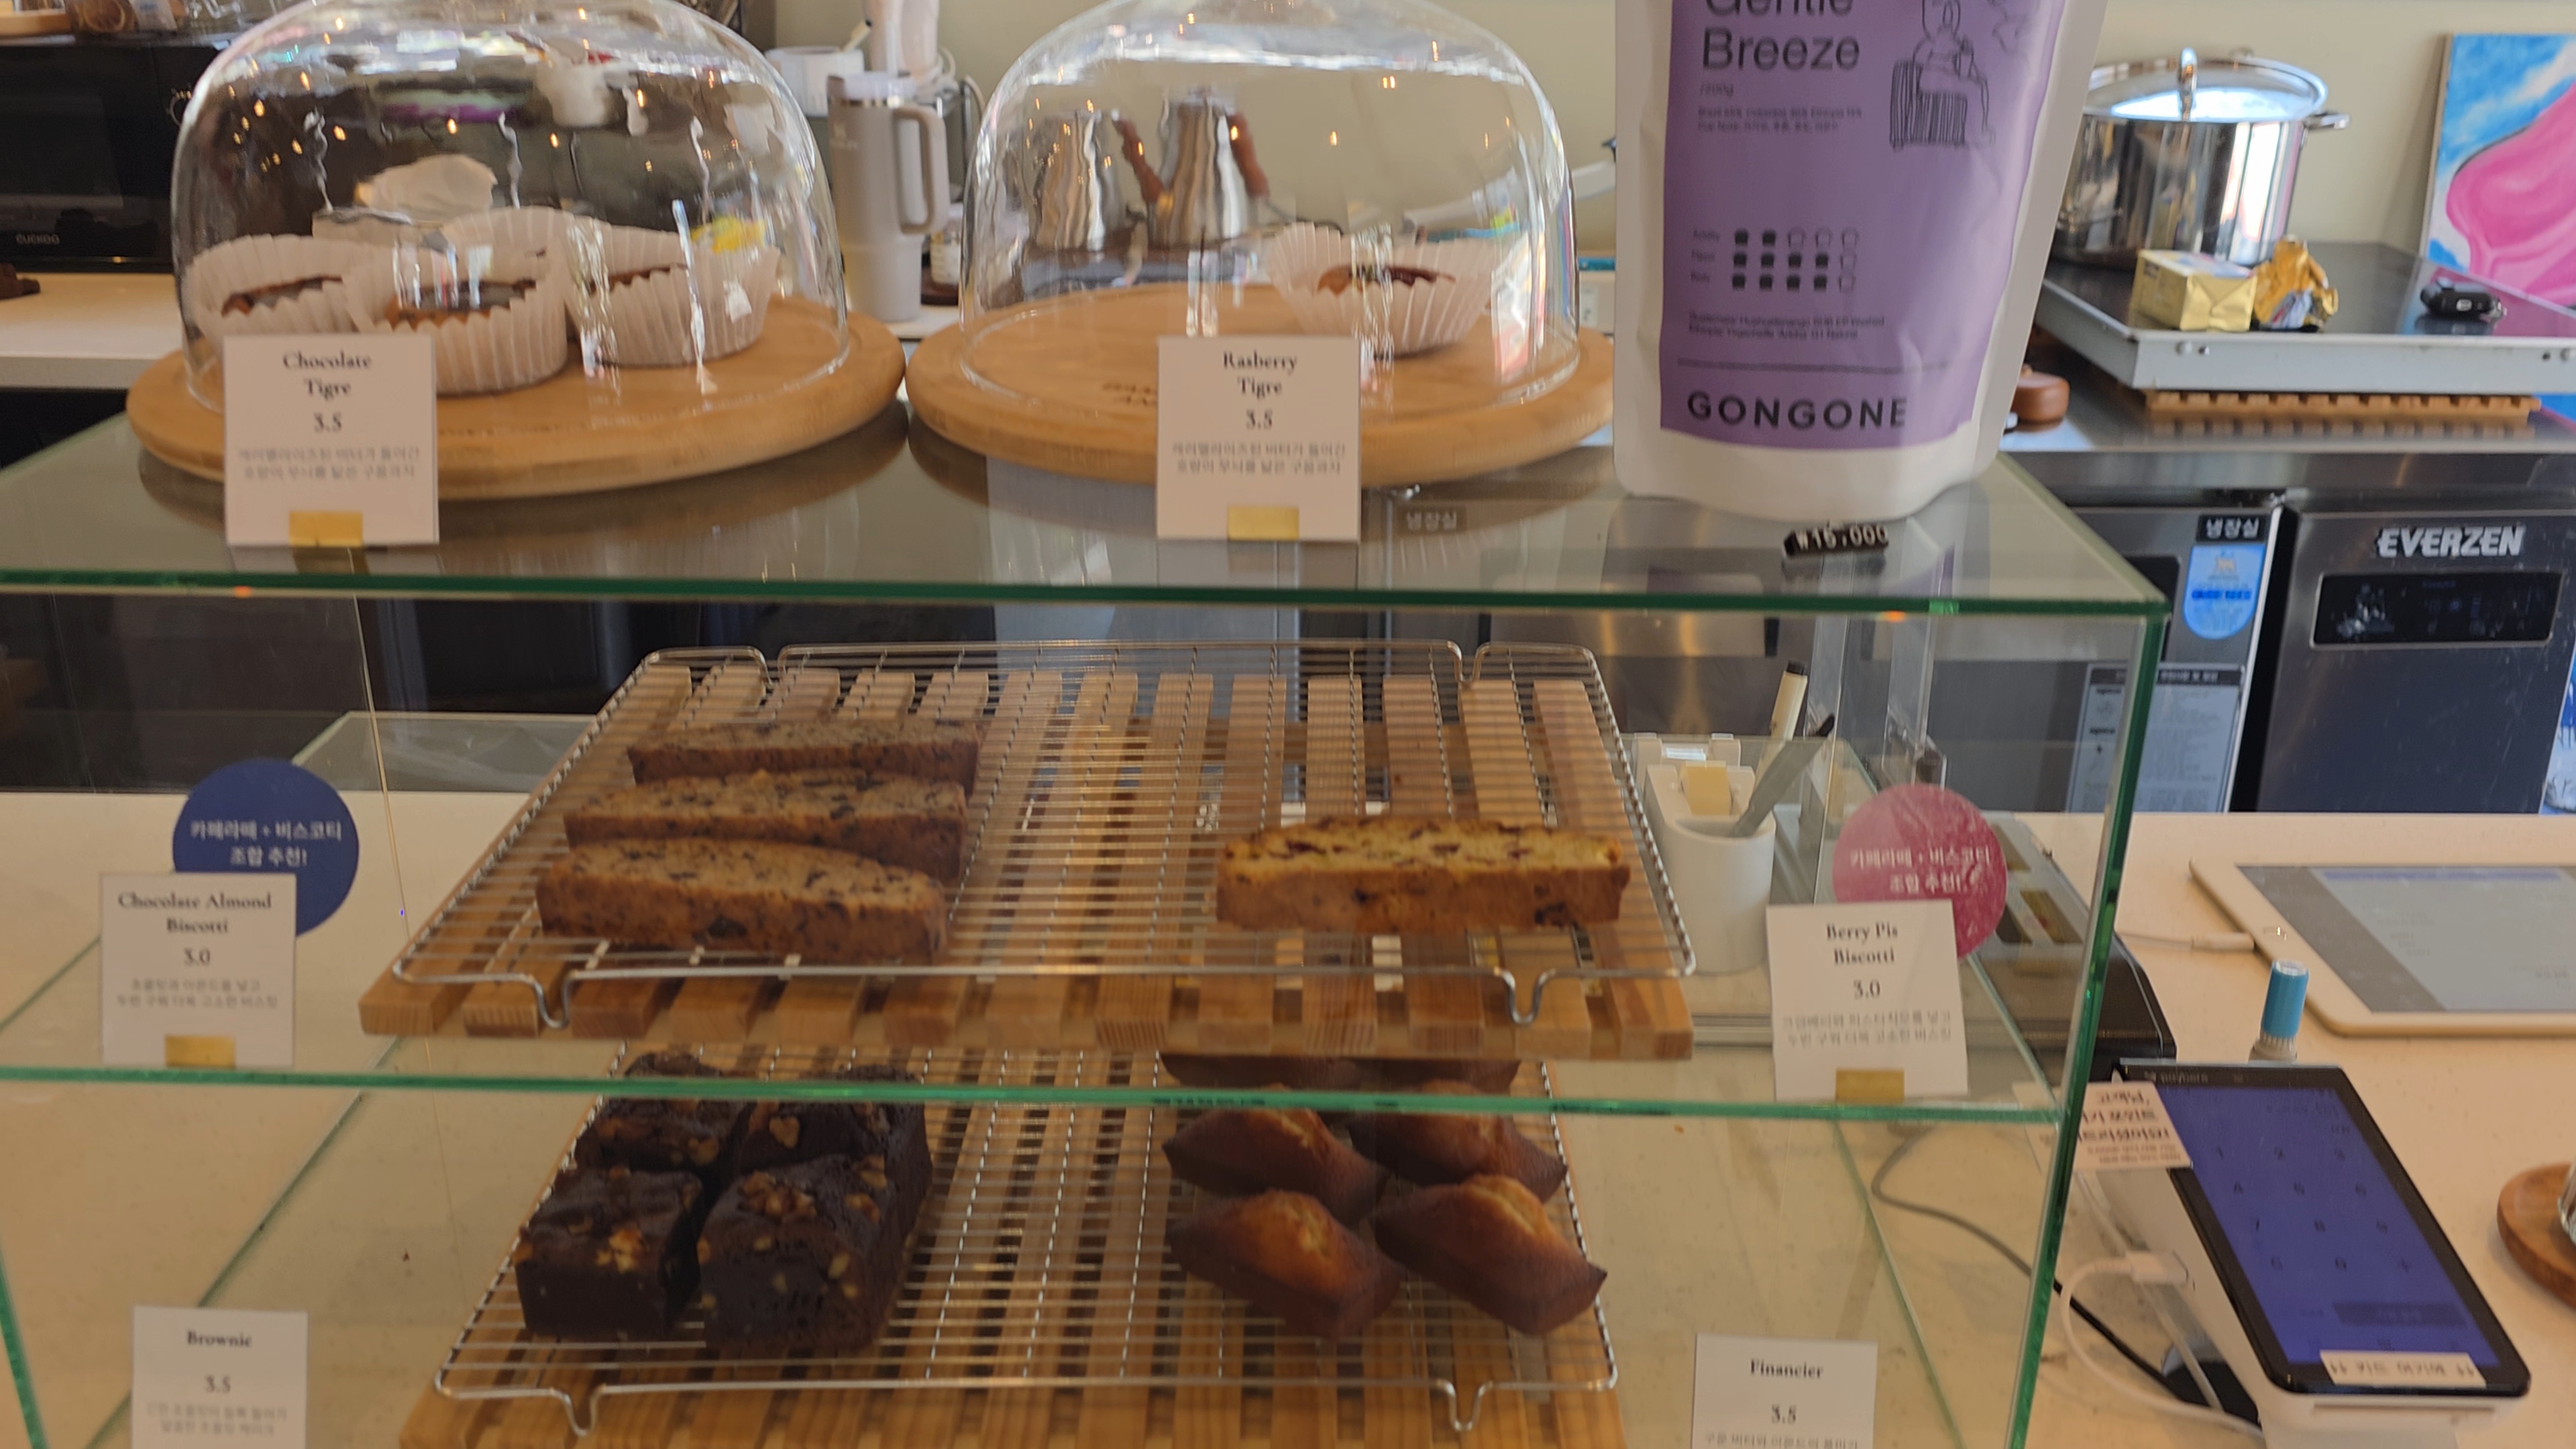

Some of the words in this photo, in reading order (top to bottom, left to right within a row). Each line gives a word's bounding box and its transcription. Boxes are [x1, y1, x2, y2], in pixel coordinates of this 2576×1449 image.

[1703, 27, 1860, 70] Breeze
[16, 233, 60, 245] CUCKOO
[283, 351, 371, 369] Chocolate
[1224, 350, 1297, 374] Rasberry
[305, 378, 351, 400] Tigre
[1238, 377, 1282, 400] Tigre
[1246, 409, 1272, 429] 3.5
[1687, 390, 1907, 430] GONGONE
[314, 413, 341, 432] 3.5
[1407, 510, 1457, 531] 냉장실
[2206, 517, 2259, 539] 냉장실
[2377, 525, 2526, 557] EVERZEN
[191, 820, 258, 841] 카페라떼
[275, 820, 341, 841] 비스코티
[229, 845, 264, 867] 조합
[268, 845, 307, 867] 추천!
[1890, 872, 1919, 894] 조합
[118, 892, 201, 910] Chocolate
[208, 892, 272, 910] Almond
[166, 918, 229, 934] Biscotti
[1827, 922, 1869, 945] Berry
[1876, 922, 1898, 938] Pis
[183, 948, 211, 965] 3.0
[1834, 947, 1894, 965] Biscotti
[1853, 979, 1880, 1000] 3.0
[186, 1330, 252, 1347] Brownie
[1750, 1358, 1823, 1379] Financier
[205, 1376, 231, 1394] 3.5
[1772, 1404, 1796, 1424] 3.5
